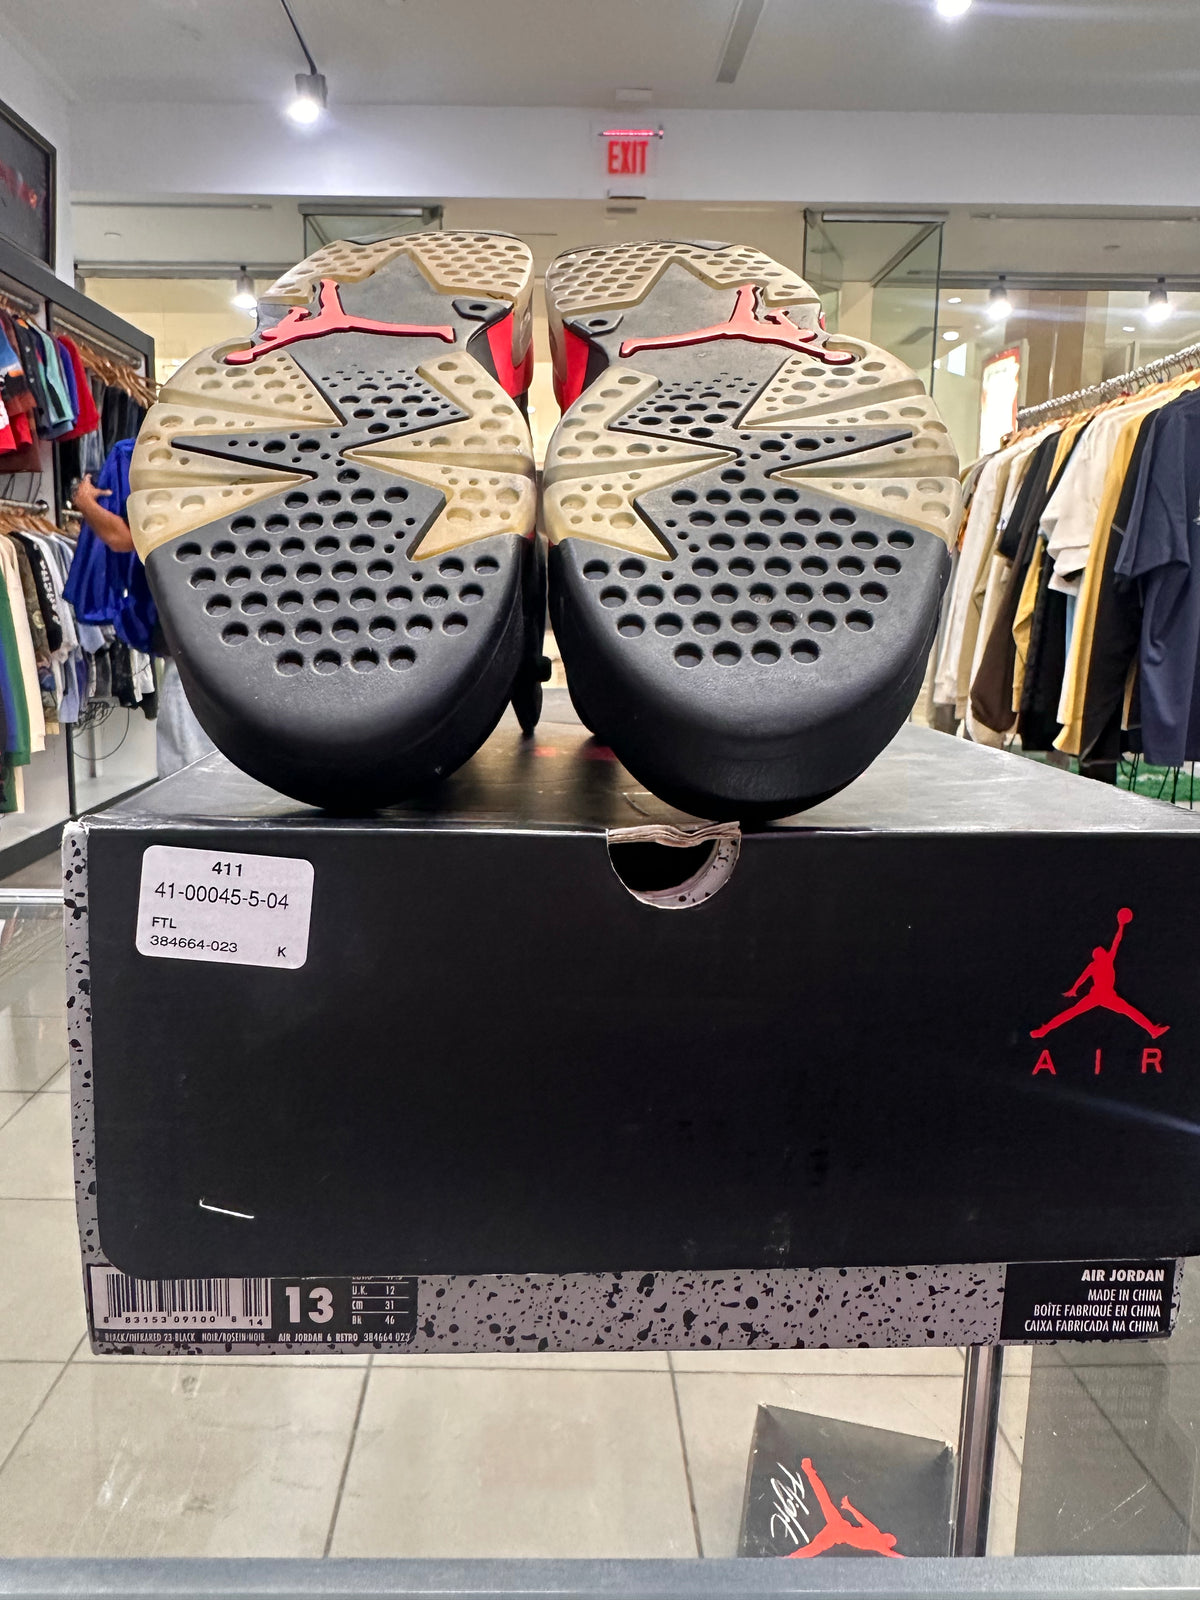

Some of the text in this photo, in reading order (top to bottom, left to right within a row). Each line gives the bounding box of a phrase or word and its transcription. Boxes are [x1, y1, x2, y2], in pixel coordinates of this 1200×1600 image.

[607, 140, 649, 174] EXIT
[211, 861, 243, 877] 411
[154, 881, 289, 910] 41-00045-5-04
[152, 916, 177, 929] FTL
[150, 935, 287, 957] 384664-023 K
[1081, 1269, 1165, 1282] AIR JORDAN
[386, 1285, 395, 1295] 12
[1087, 1289, 1163, 1302] MADE IN CHINA
[285, 1286, 334, 1324] 13
[385, 1300, 394, 1310] 31
[1033, 1302, 1161, 1317] BOÎTE FABRIQUÉ EN CHINA
[384, 1315, 395, 1325] 46
[1024, 1319, 1159, 1332] CAIXA FABRICADA NA CHINA
